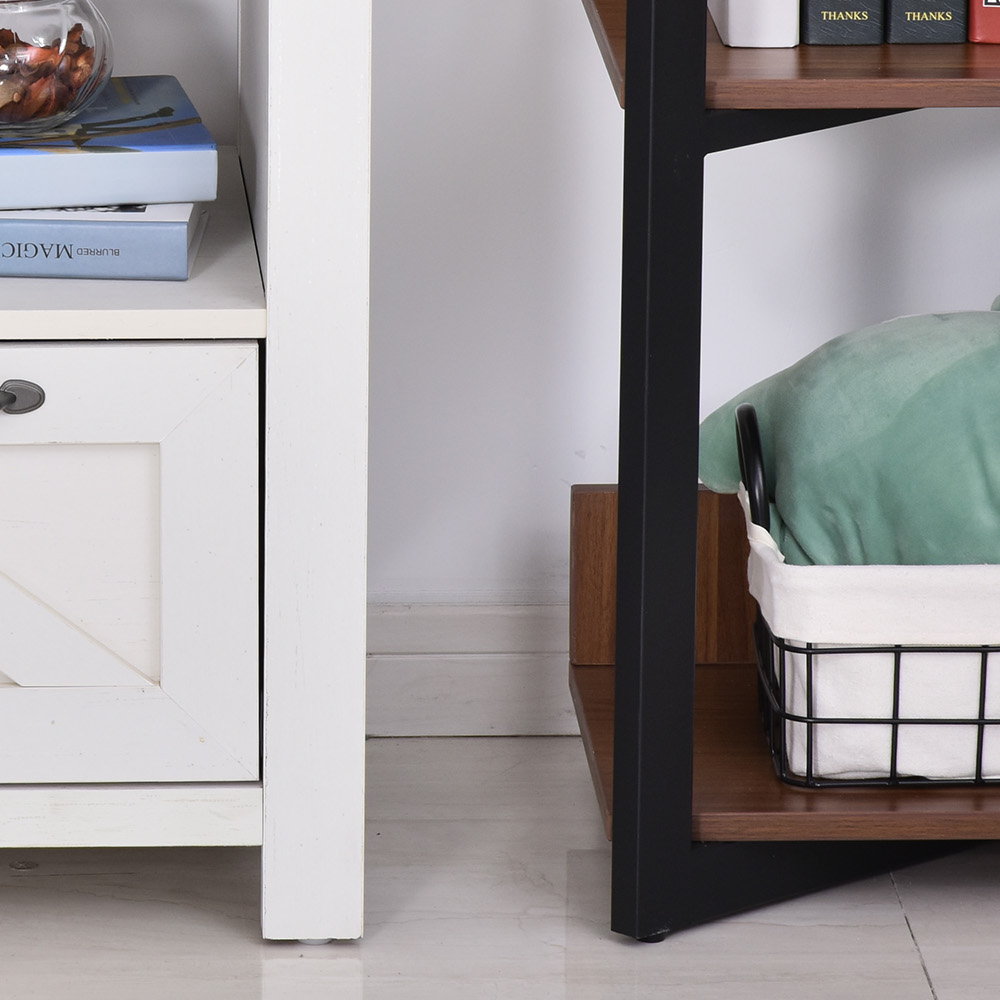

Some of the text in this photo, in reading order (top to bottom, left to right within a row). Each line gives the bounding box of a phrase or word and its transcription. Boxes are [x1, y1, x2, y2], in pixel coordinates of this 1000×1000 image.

[820, 10, 869, 21] THANKS
[904, 11, 953, 22] THANKS
[1, 242, 120, 260] BLURRED MAGIC
